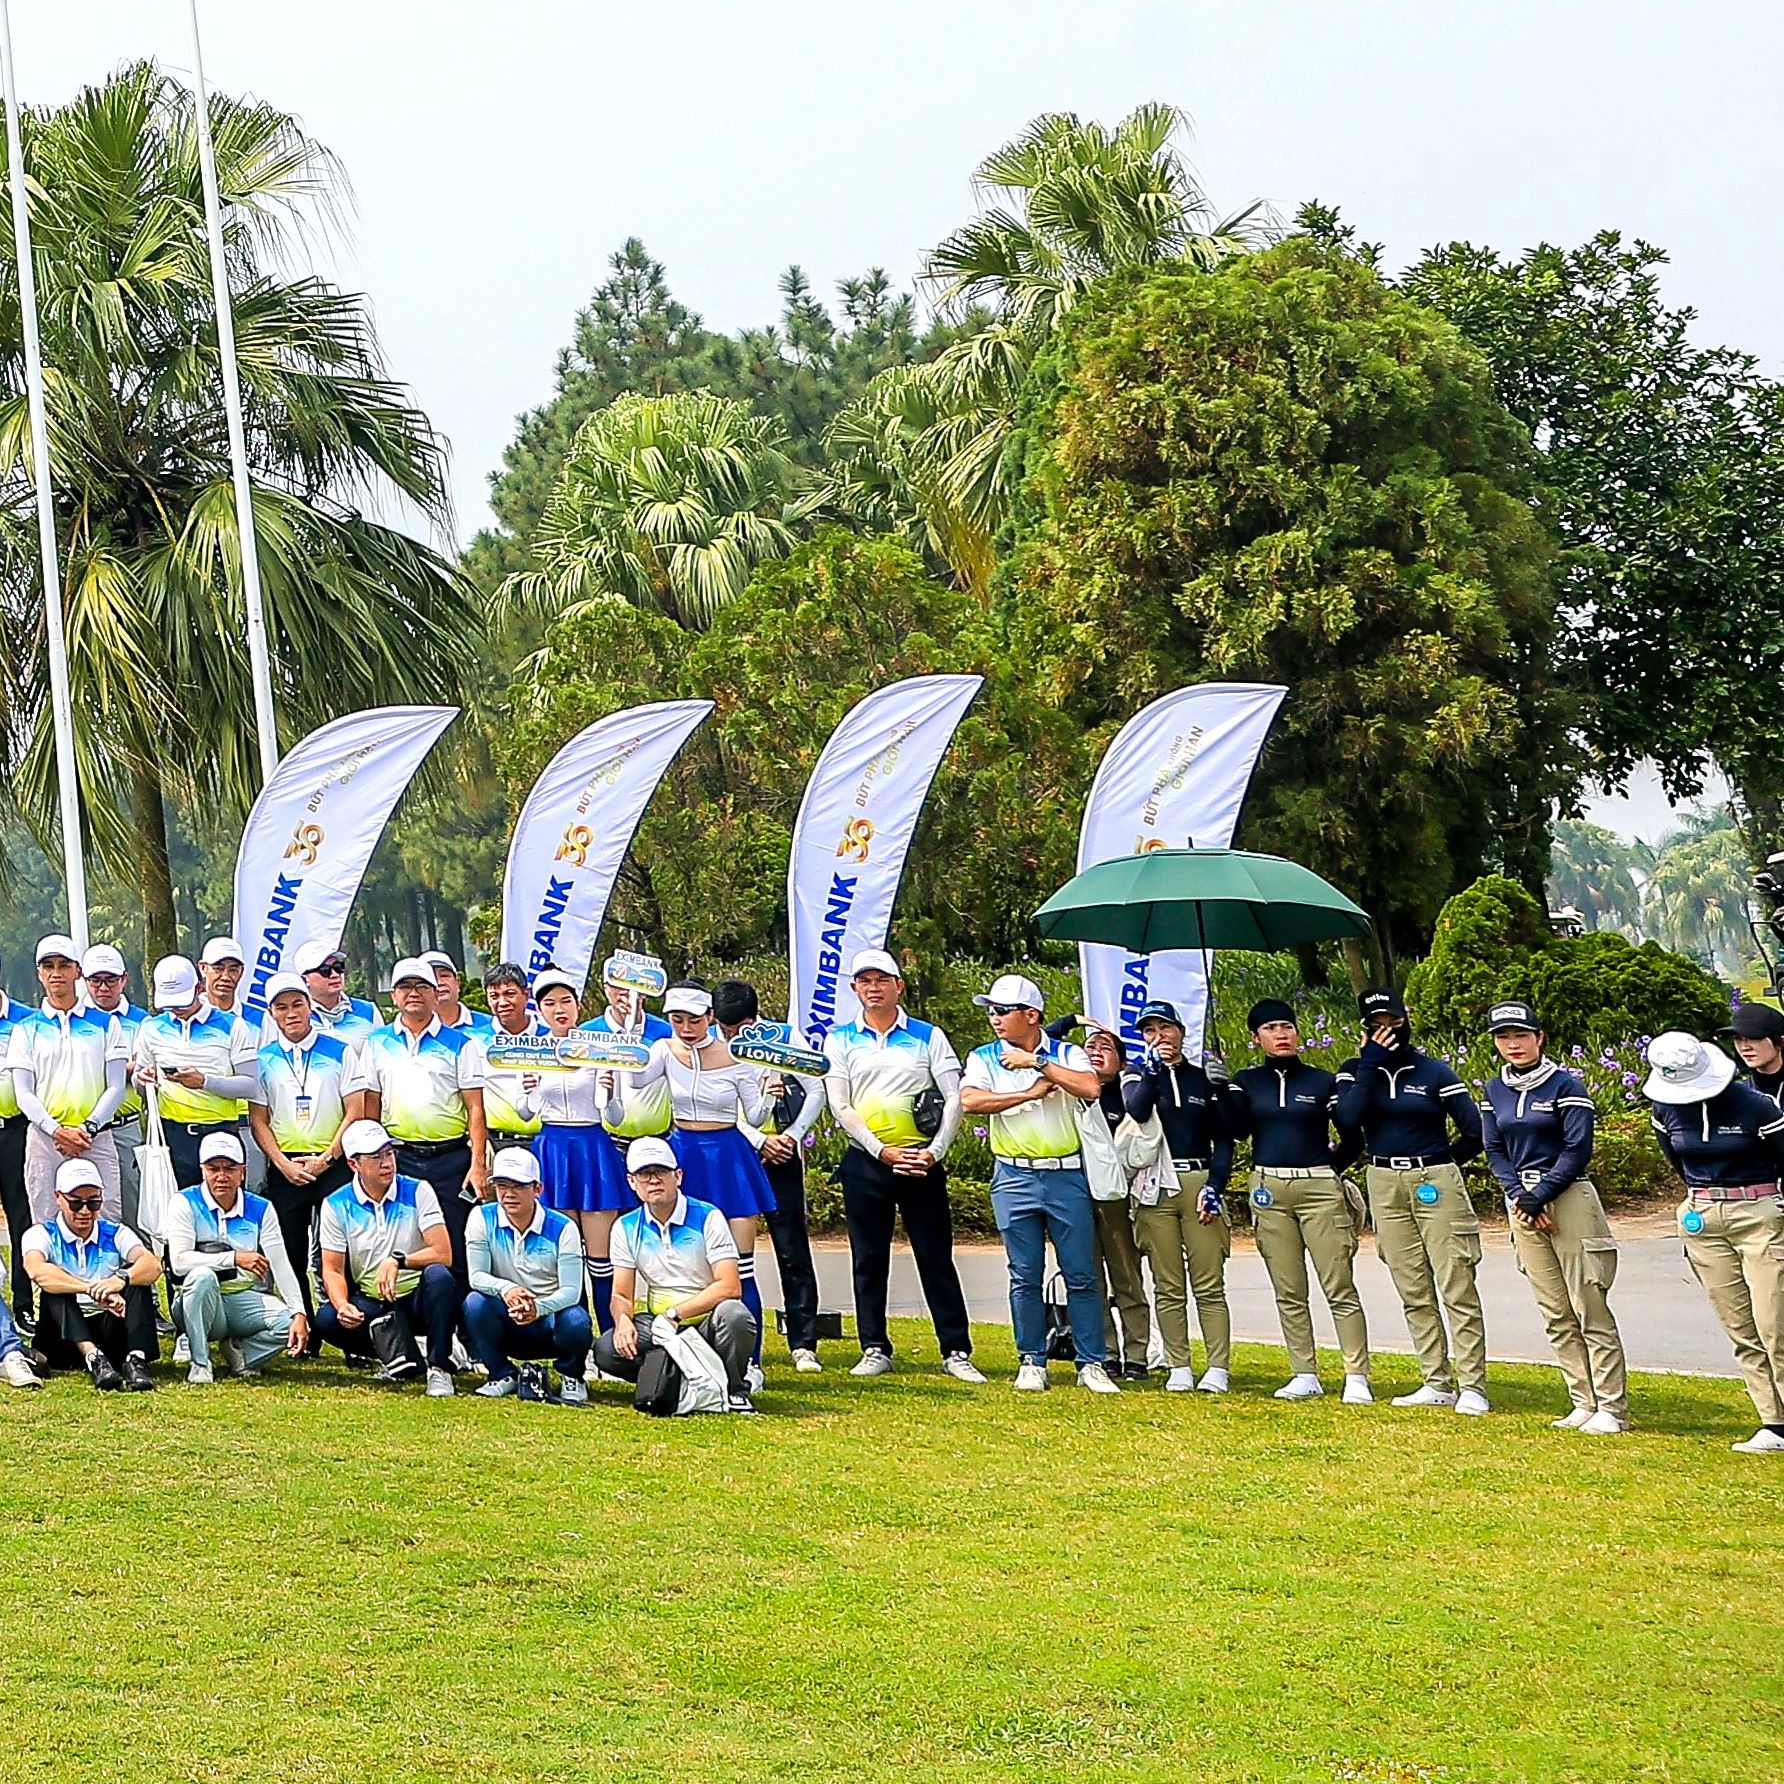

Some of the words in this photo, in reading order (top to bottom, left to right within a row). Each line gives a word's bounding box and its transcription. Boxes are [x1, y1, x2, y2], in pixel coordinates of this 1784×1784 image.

[495, 1036, 559, 1047] EXIMBAN
[571, 1031, 638, 1045] EXIMBANK
[738, 1046, 744, 1056] I
[746, 1047, 782, 1064] LOVE
